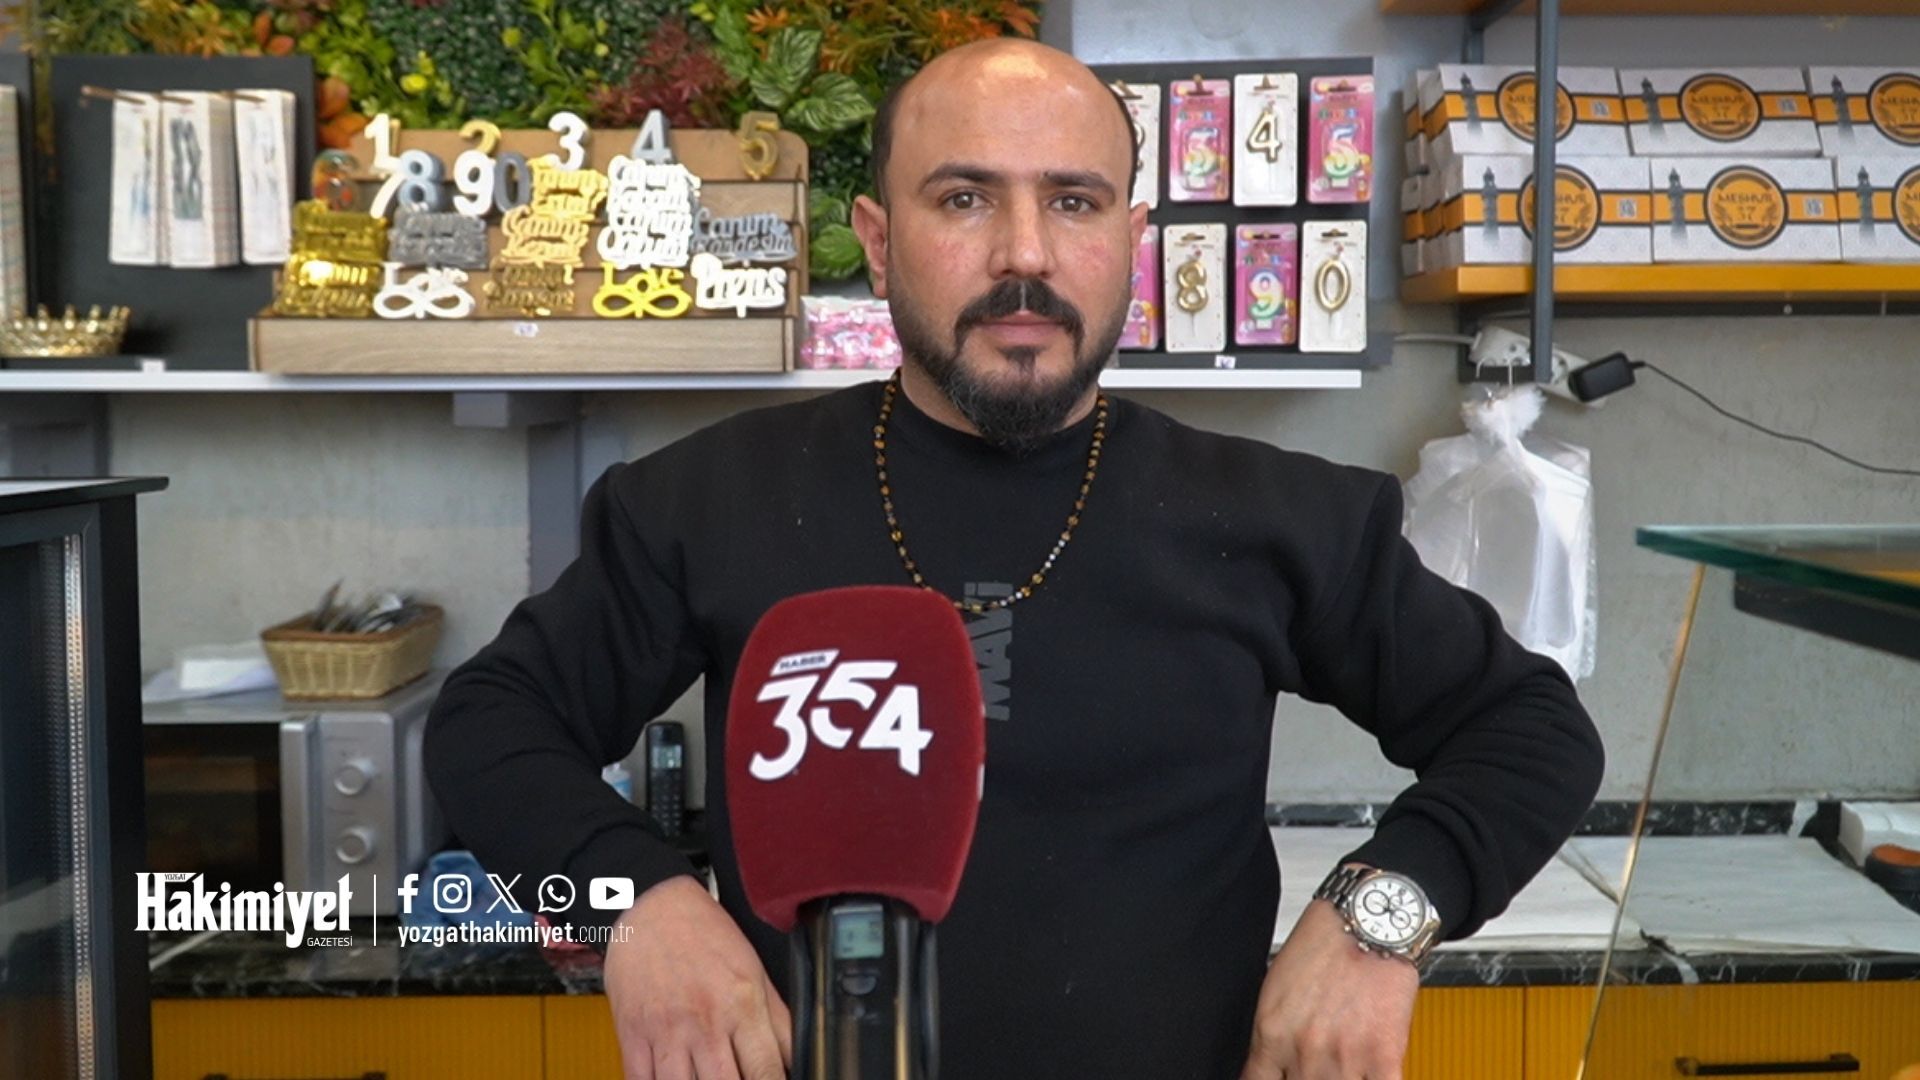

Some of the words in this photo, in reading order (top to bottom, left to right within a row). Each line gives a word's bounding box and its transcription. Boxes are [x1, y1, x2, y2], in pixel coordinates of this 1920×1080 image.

[548, 111, 587, 171] 3
[631, 109, 675, 162] 4
[739, 111, 780, 178] 5
[1247, 111, 1282, 163] 4
[399, 150, 441, 208] 8
[453, 150, 495, 216] 9
[493, 153, 533, 214] 0
[1177, 259, 1209, 314] 8
[1250, 270, 1285, 319] 9
[1315, 260, 1351, 313] 0
[779, 654, 827, 670] HABER
[749, 659, 934, 781] 354
